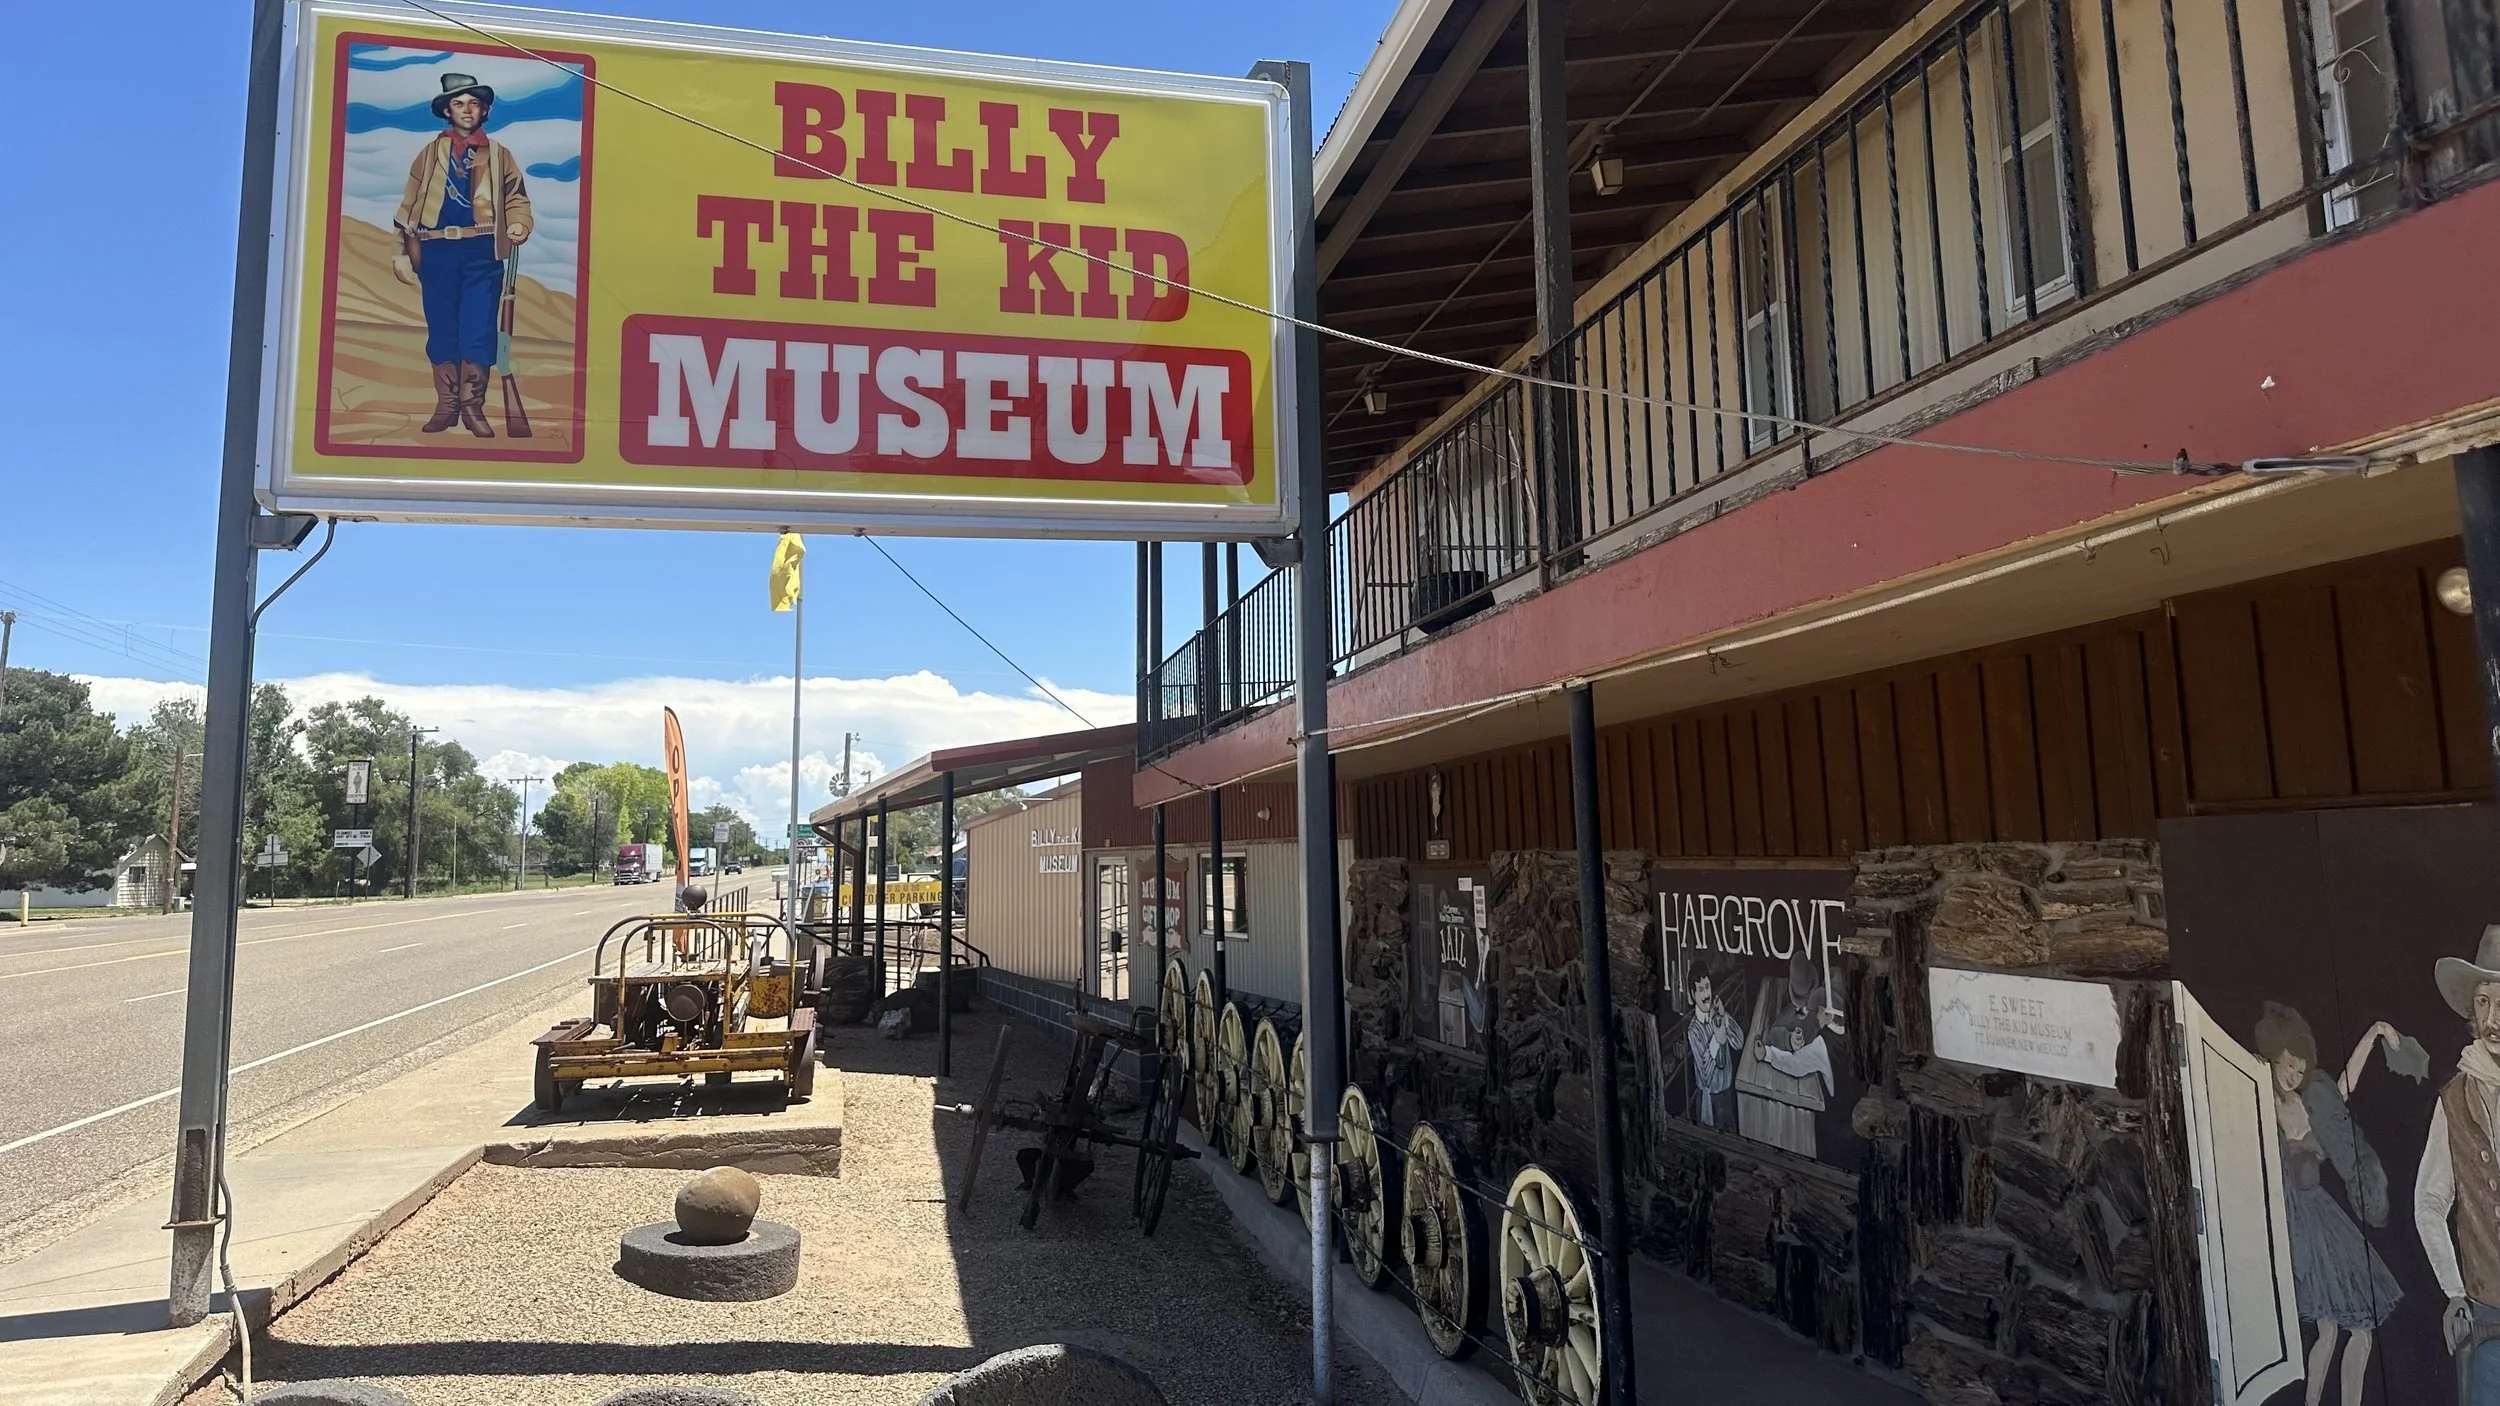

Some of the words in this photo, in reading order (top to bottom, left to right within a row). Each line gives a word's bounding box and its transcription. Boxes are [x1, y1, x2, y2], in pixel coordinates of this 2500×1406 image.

[773, 81, 1120, 204] BILLY
[696, 194, 937, 308] THE
[998, 218, 1190, 322] KID
[647, 332, 1232, 468] MUSEUM
[1031, 828, 1056, 847] BILLY
[1071, 827, 1081, 844] KI
[1040, 854, 1079, 872] MUSEUM
[866, 884, 919, 893] MSEUM
[900, 892, 942, 903] PARKING
[1142, 877, 1180, 900] MUUM
[1440, 925, 1466, 968] JAIL
[1658, 892, 1845, 1017] HARGROVE
[2001, 996, 2045, 1018] SWEET
[1969, 1013, 1991, 1029] BILLY
[1994, 1017, 2011, 1032] THE
[2012, 1019, 2028, 1034] KID
[2037, 1041, 2069, 1057] MEXICO
